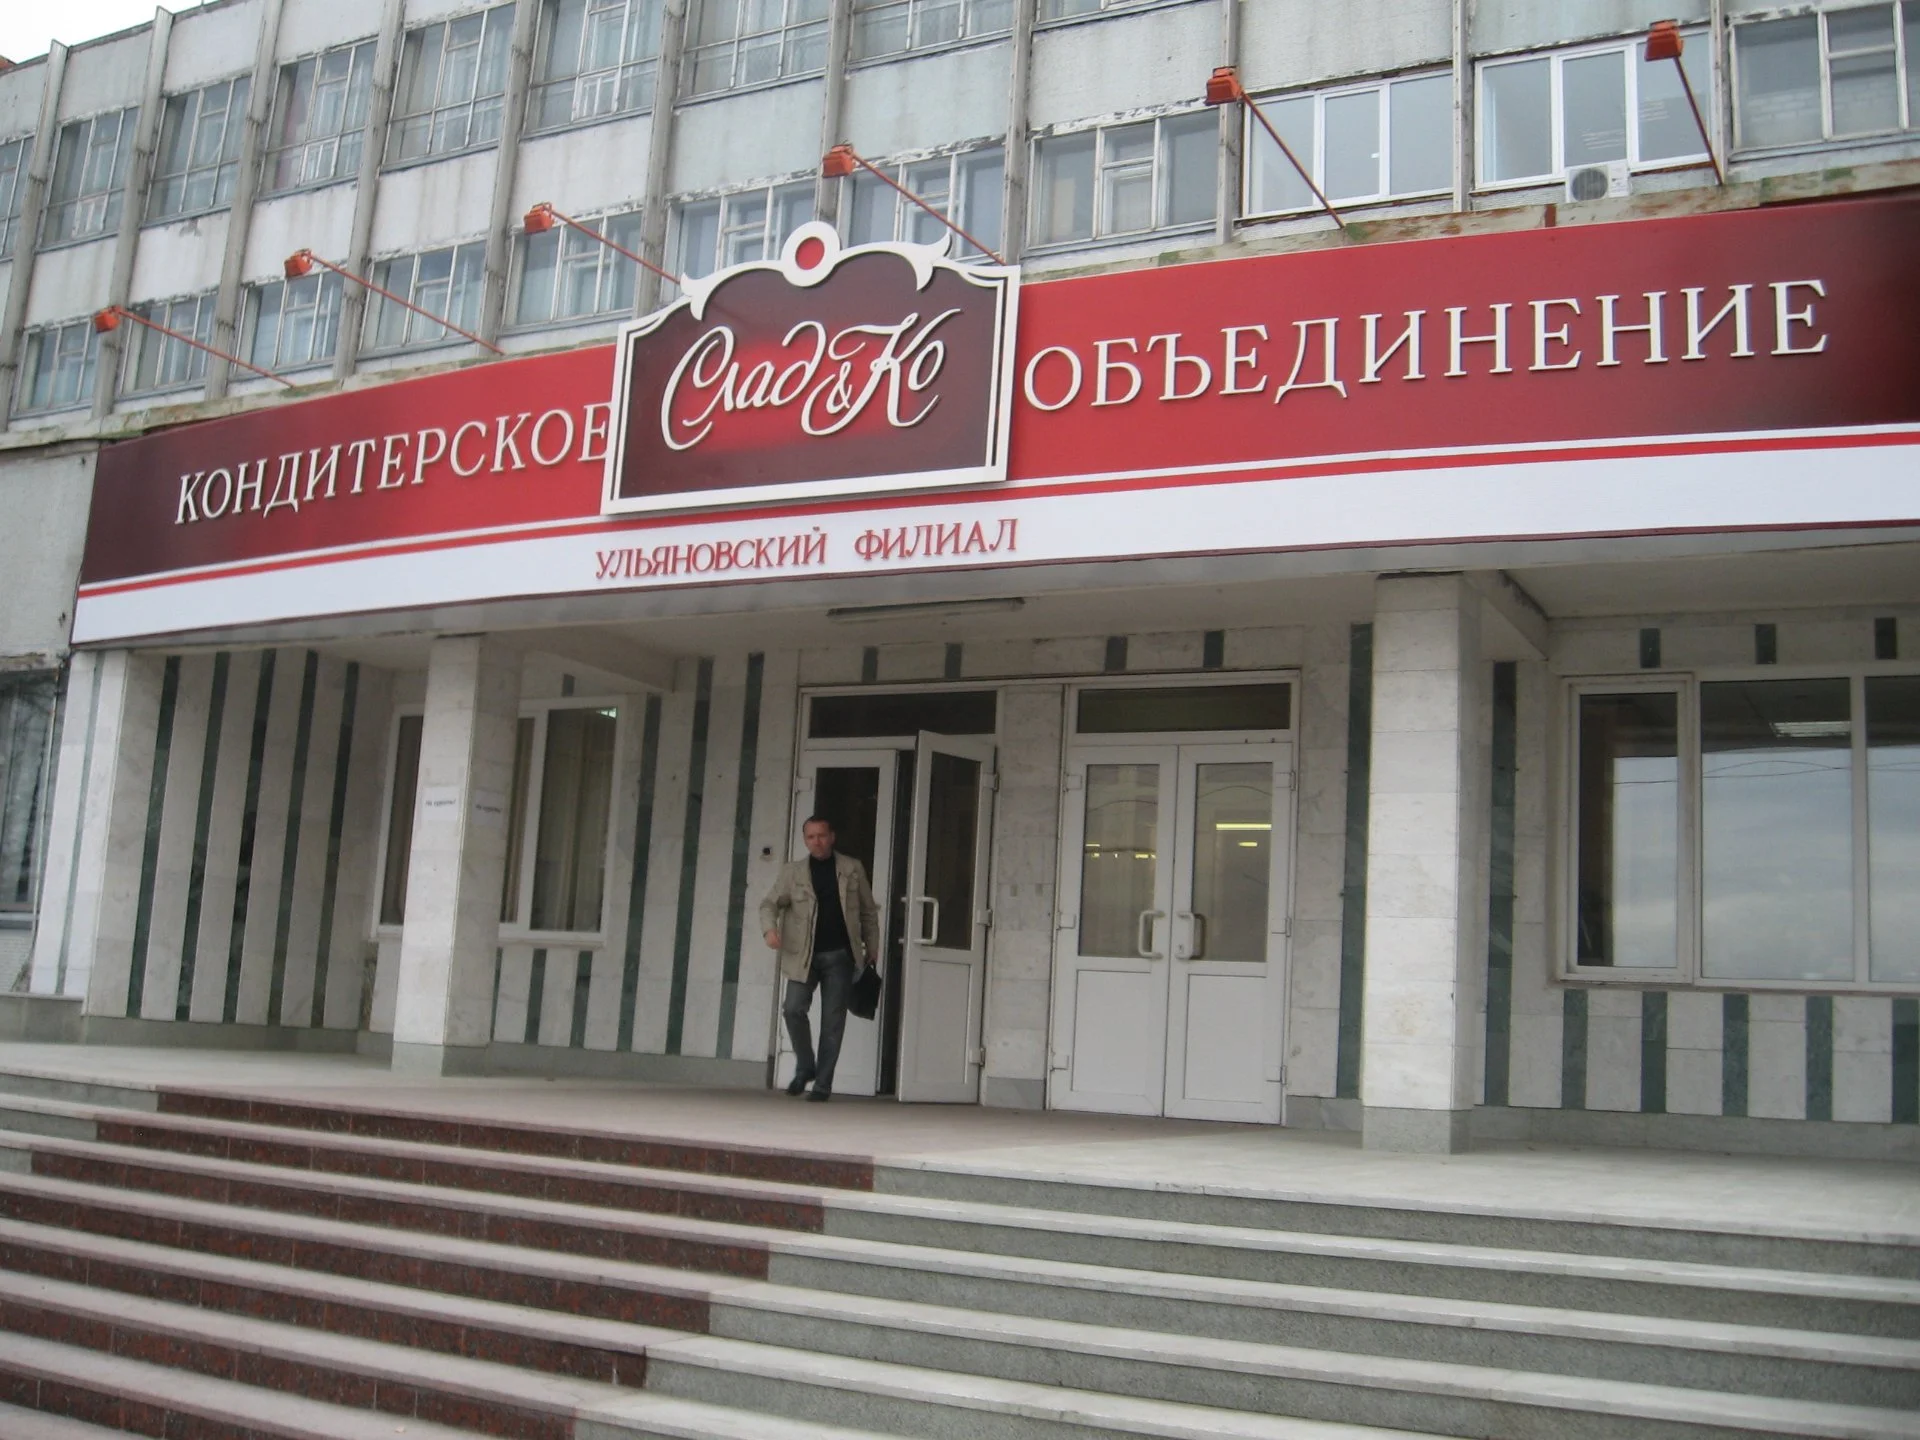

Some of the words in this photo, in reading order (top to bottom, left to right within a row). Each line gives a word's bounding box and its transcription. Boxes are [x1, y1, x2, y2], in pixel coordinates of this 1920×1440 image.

[174, 401, 610, 525] КОНДИТЕРСКОЕ
[1023, 279, 1828, 412] ОБЪЕДИНЕНИЕ
[595, 526, 828, 579] УЛЬЯНОВСКИЙ
[854, 519, 1018, 561] ФИЛИАЛ
